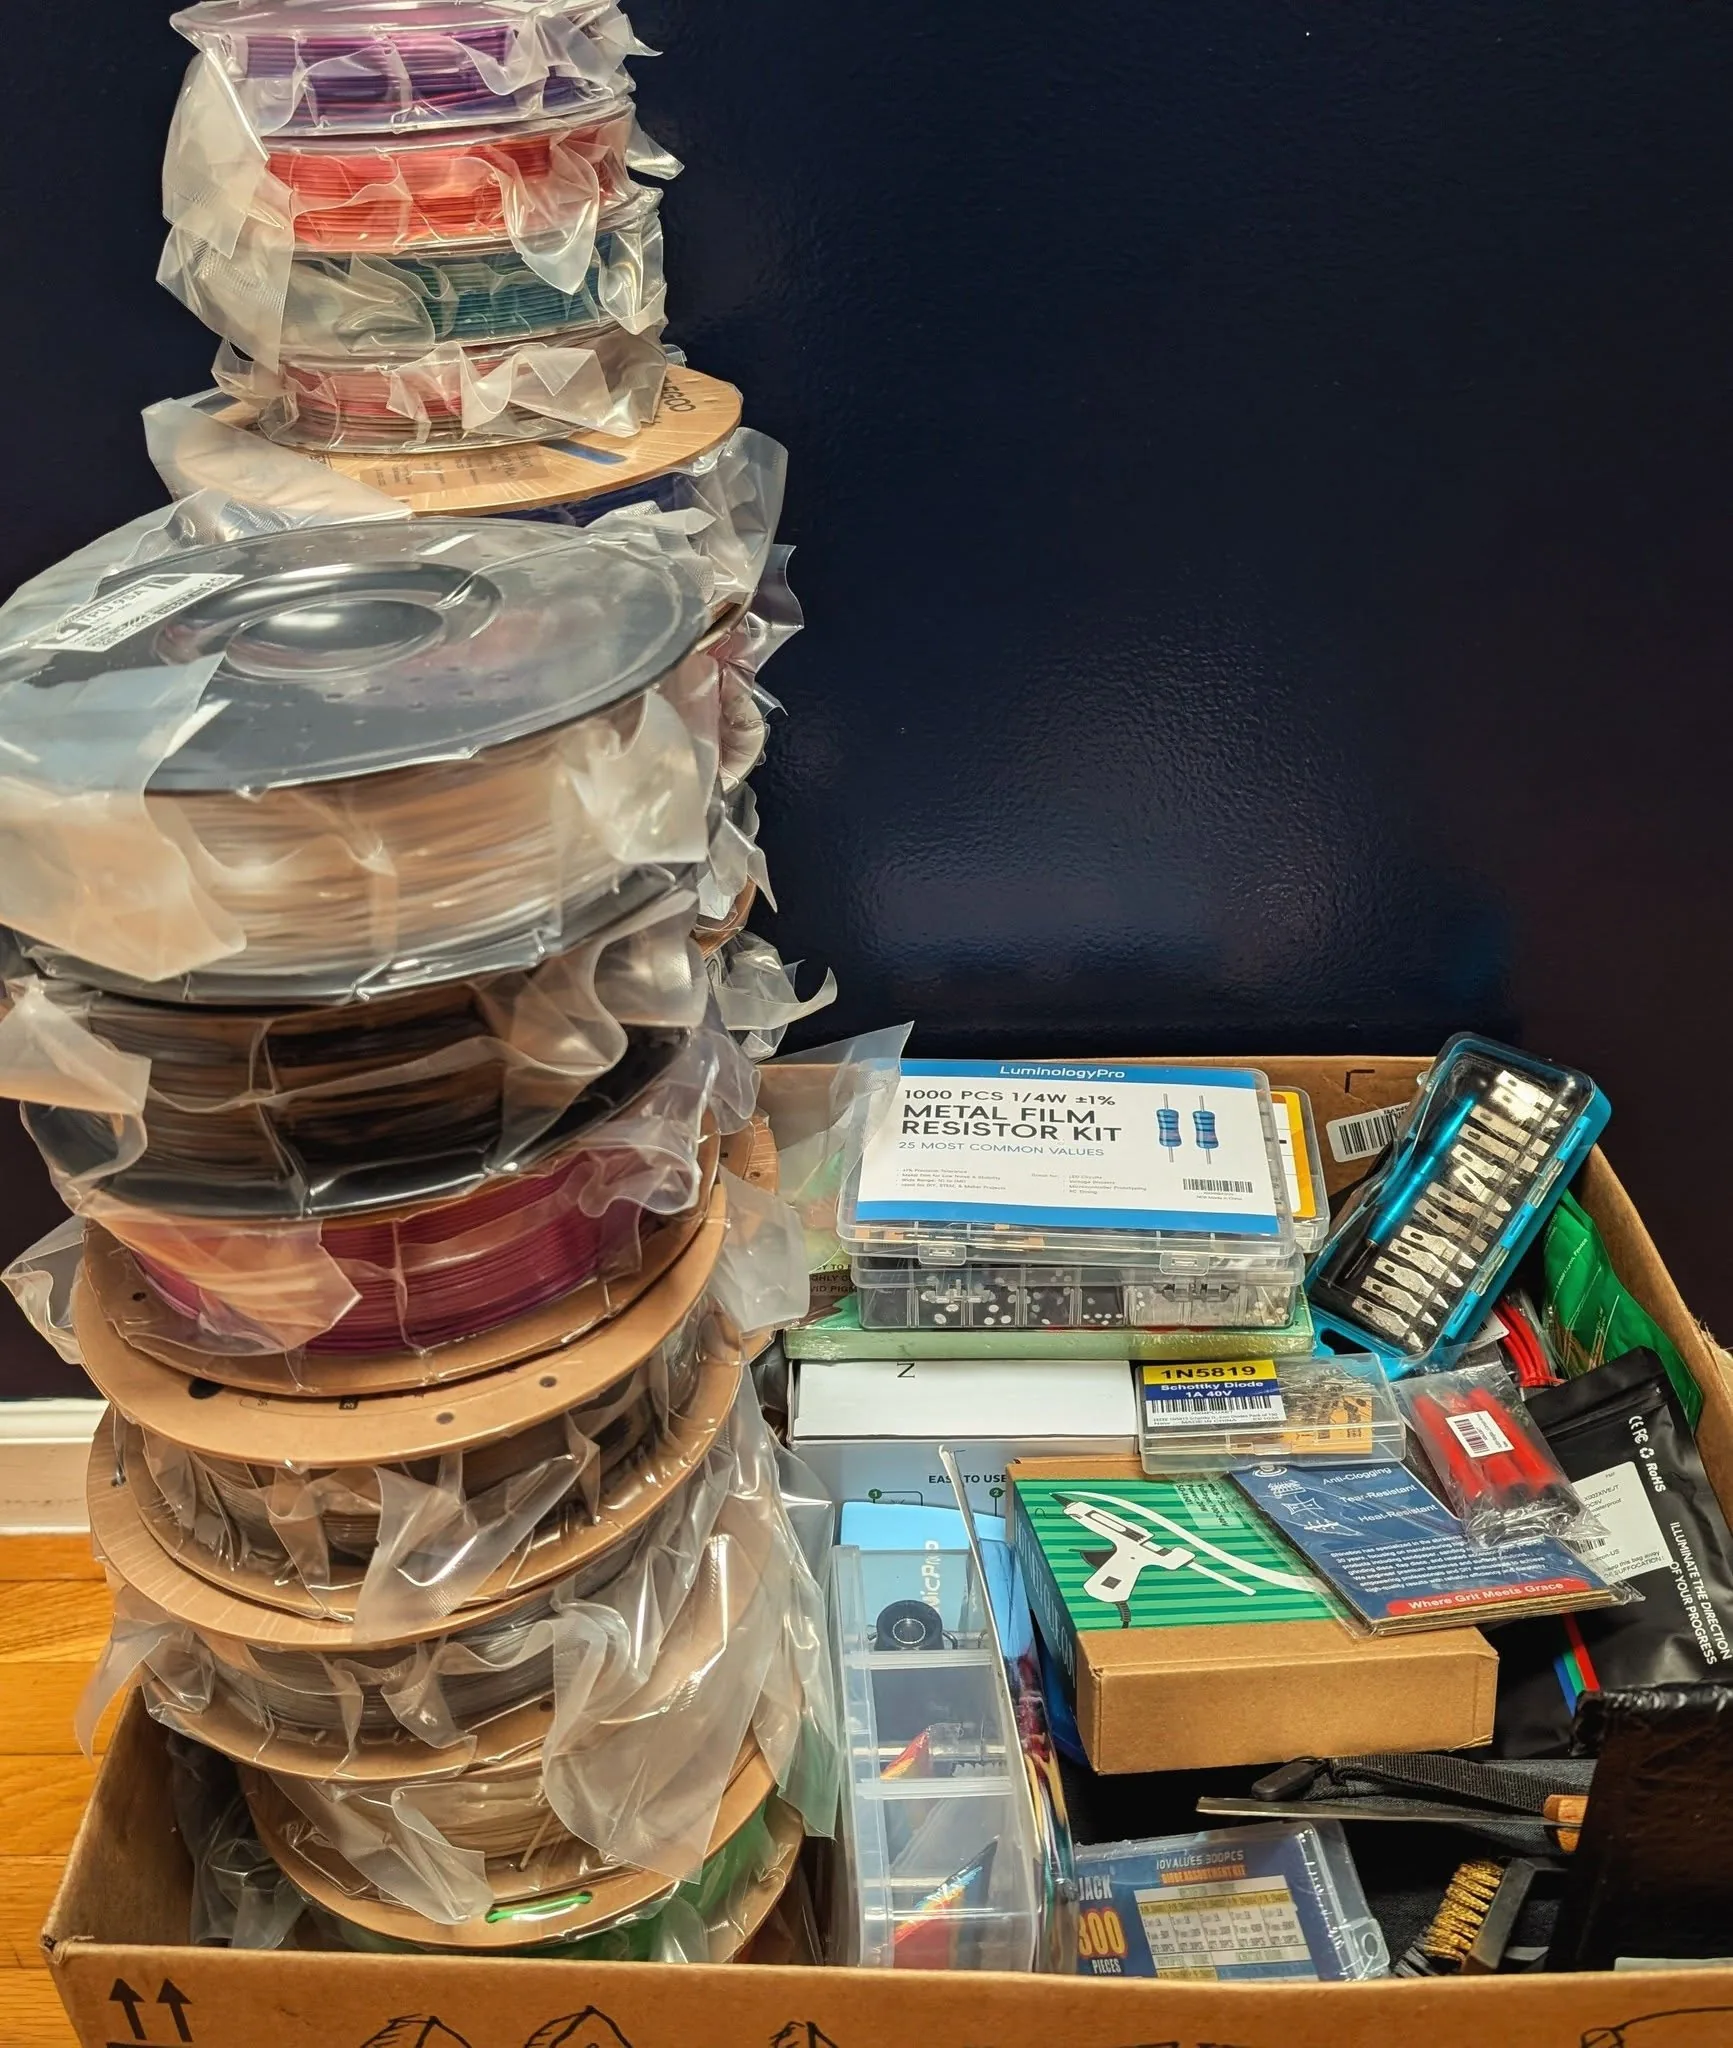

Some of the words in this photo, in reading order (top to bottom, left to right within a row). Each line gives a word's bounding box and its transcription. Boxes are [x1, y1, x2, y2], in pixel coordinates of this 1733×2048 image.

[1000, 1065, 1125, 1079] LuminologyPro
[905, 1089, 952, 1100] 1000
[961, 1090, 1003, 1101] PCS
[1012, 1092, 1067, 1104] 1/4W
[1075, 1095, 1116, 1107] ±1%
[903, 1104, 1008, 1121] METAL
[1021, 1107, 1095, 1124] FILM
[901, 1120, 1058, 1140] RESISTOR
[1073, 1126, 1122, 1142] KIT
[899, 1141, 915, 1149] 25
[921, 1141, 965, 1151] MOST
[969, 1143, 1044, 1154] COMMON
[1049, 1147, 1105, 1157] VALUES
[1160, 1365, 1257, 1380] 1N5819
[1161, 1381, 1220, 1391] Schottky
[1223, 1380, 1264, 1389] Diode
[1185, 1390, 1204, 1398] 1A
[1206, 1389, 1233, 1397] 40V
[928, 1474, 952, 1484] EAS
[964, 1474, 980, 1484] TO
[984, 1474, 1007, 1483] USE
[1323, 1466, 1392, 1485] Anti-Clogging
[1645, 1462, 1667, 1493] RoHS
[1340, 1484, 1418, 1504] Tear-Resistant
[1358, 1504, 1439, 1522] Heat-Resistant
[1591, 1497, 1622, 1513] aterproof
[1631, 1555, 1644, 1563] bag
[1669, 1521, 1700, 1581] ILLUMINATE
[1669, 1561, 1683, 1578] OF
[1408, 1595, 1453, 1610] Where
[1454, 1590, 1481, 1604] Grit
[1482, 1585, 1522, 1600] Meets
[1524, 1581, 1564, 1595] Grace
[1672, 1572, 1694, 1607] YOUR
[1694, 1577, 1709, 1603] THE
[1686, 1605, 1717, 1665] PROGRESS
[1700, 1601, 1733, 1660] DIRECTION
[1206, 1850, 1245, 1865] 300PCS
[1091, 1958, 1122, 1974] PIECES
